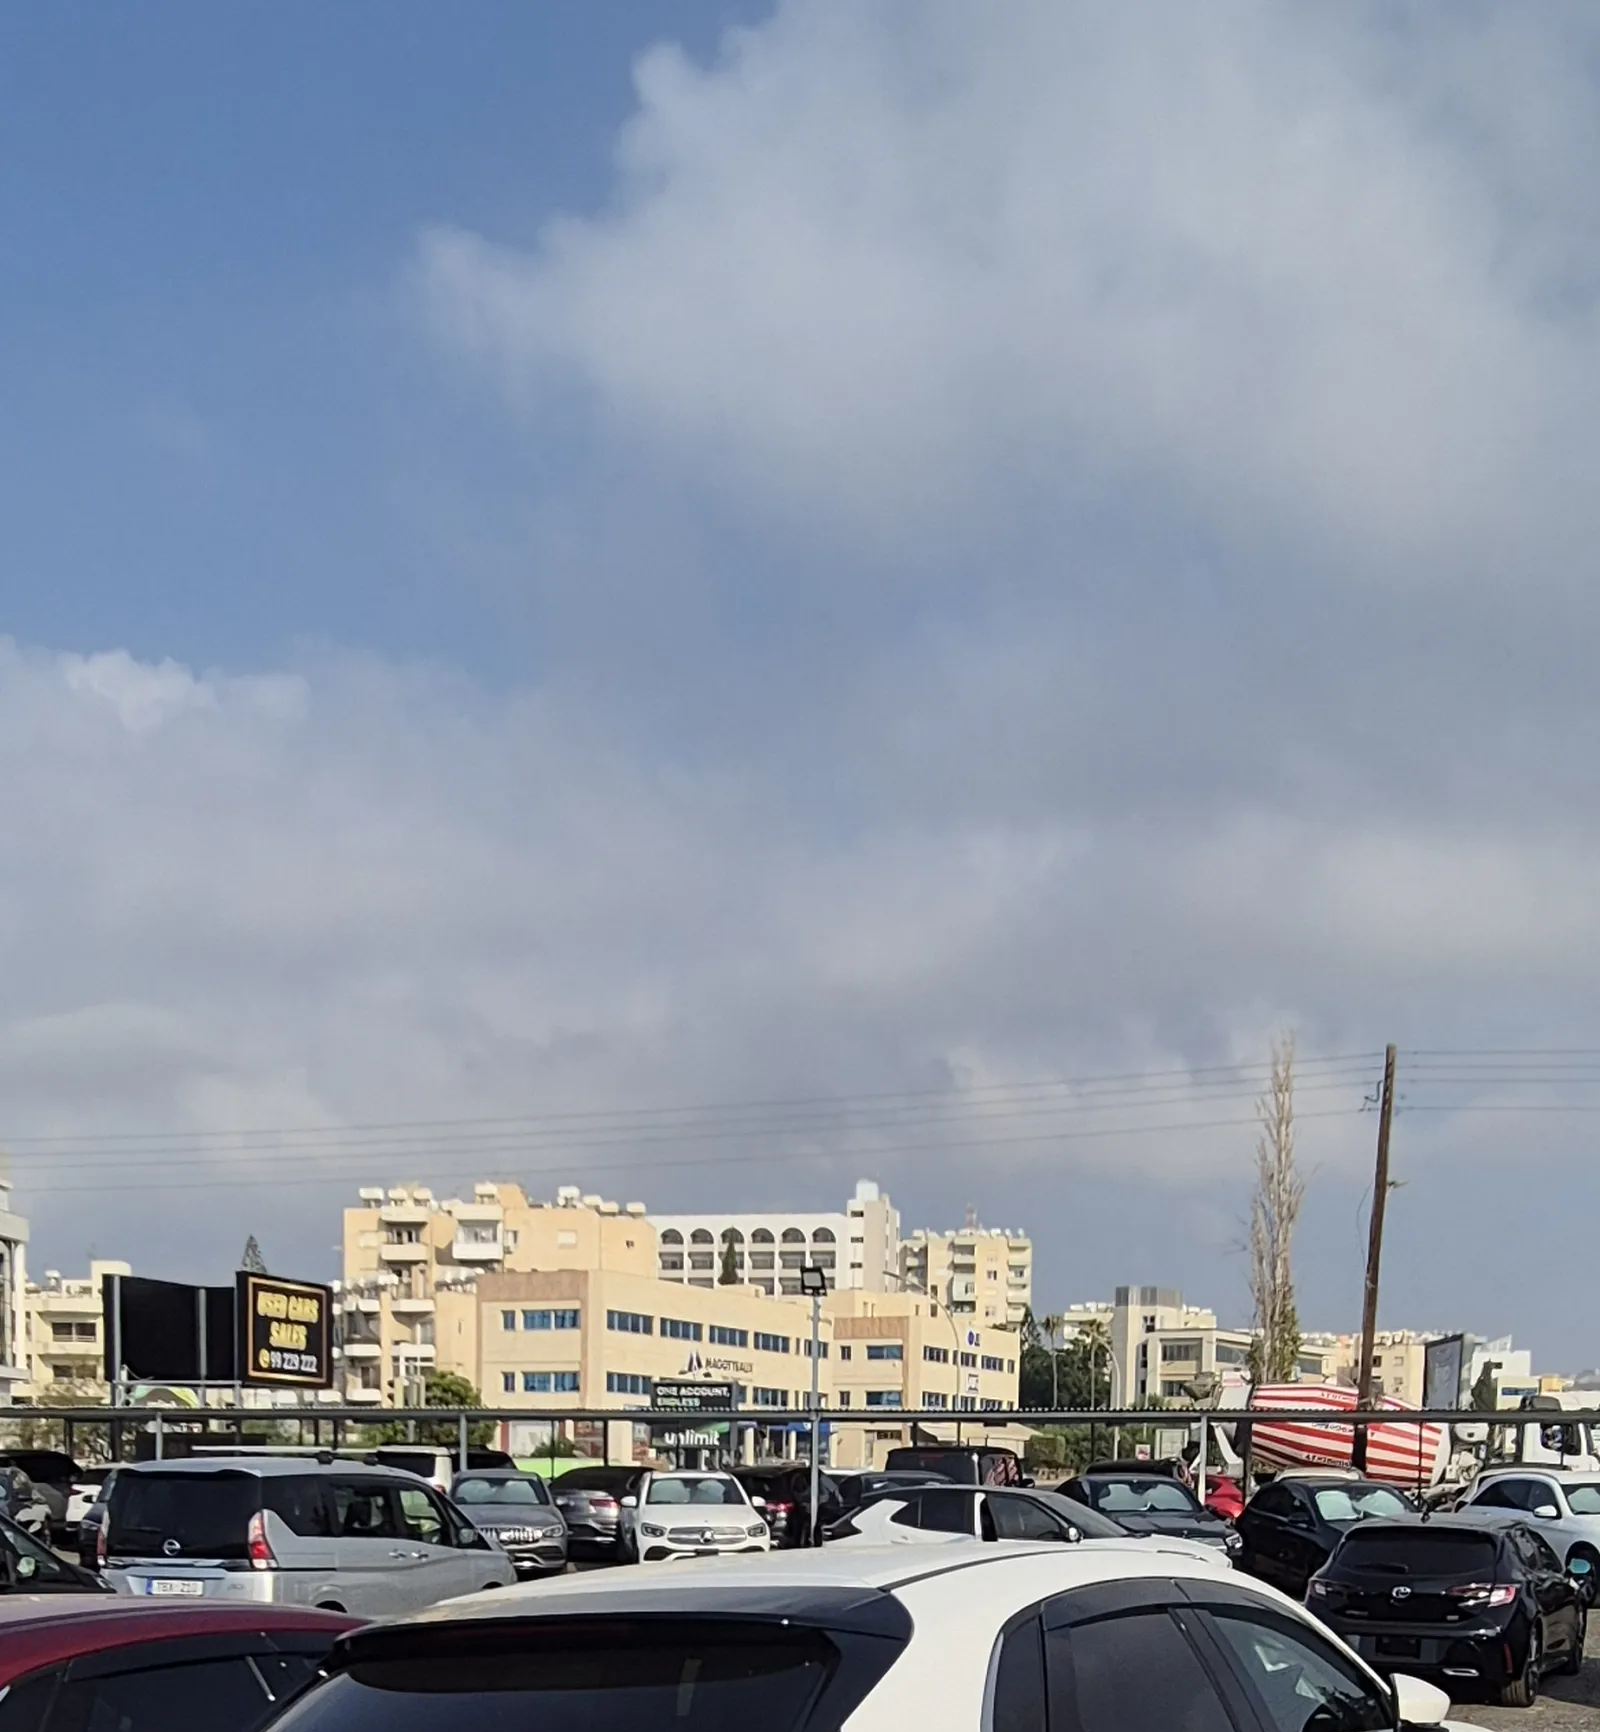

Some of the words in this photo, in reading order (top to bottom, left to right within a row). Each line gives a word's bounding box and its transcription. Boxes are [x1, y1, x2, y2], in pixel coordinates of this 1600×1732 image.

[257, 1291, 288, 1319] USED
[288, 1295, 319, 1323] CARS
[269, 1321, 307, 1350] SALES
[656, 1386, 678, 1397] ONE
[664, 1429, 720, 1446] unlimit
